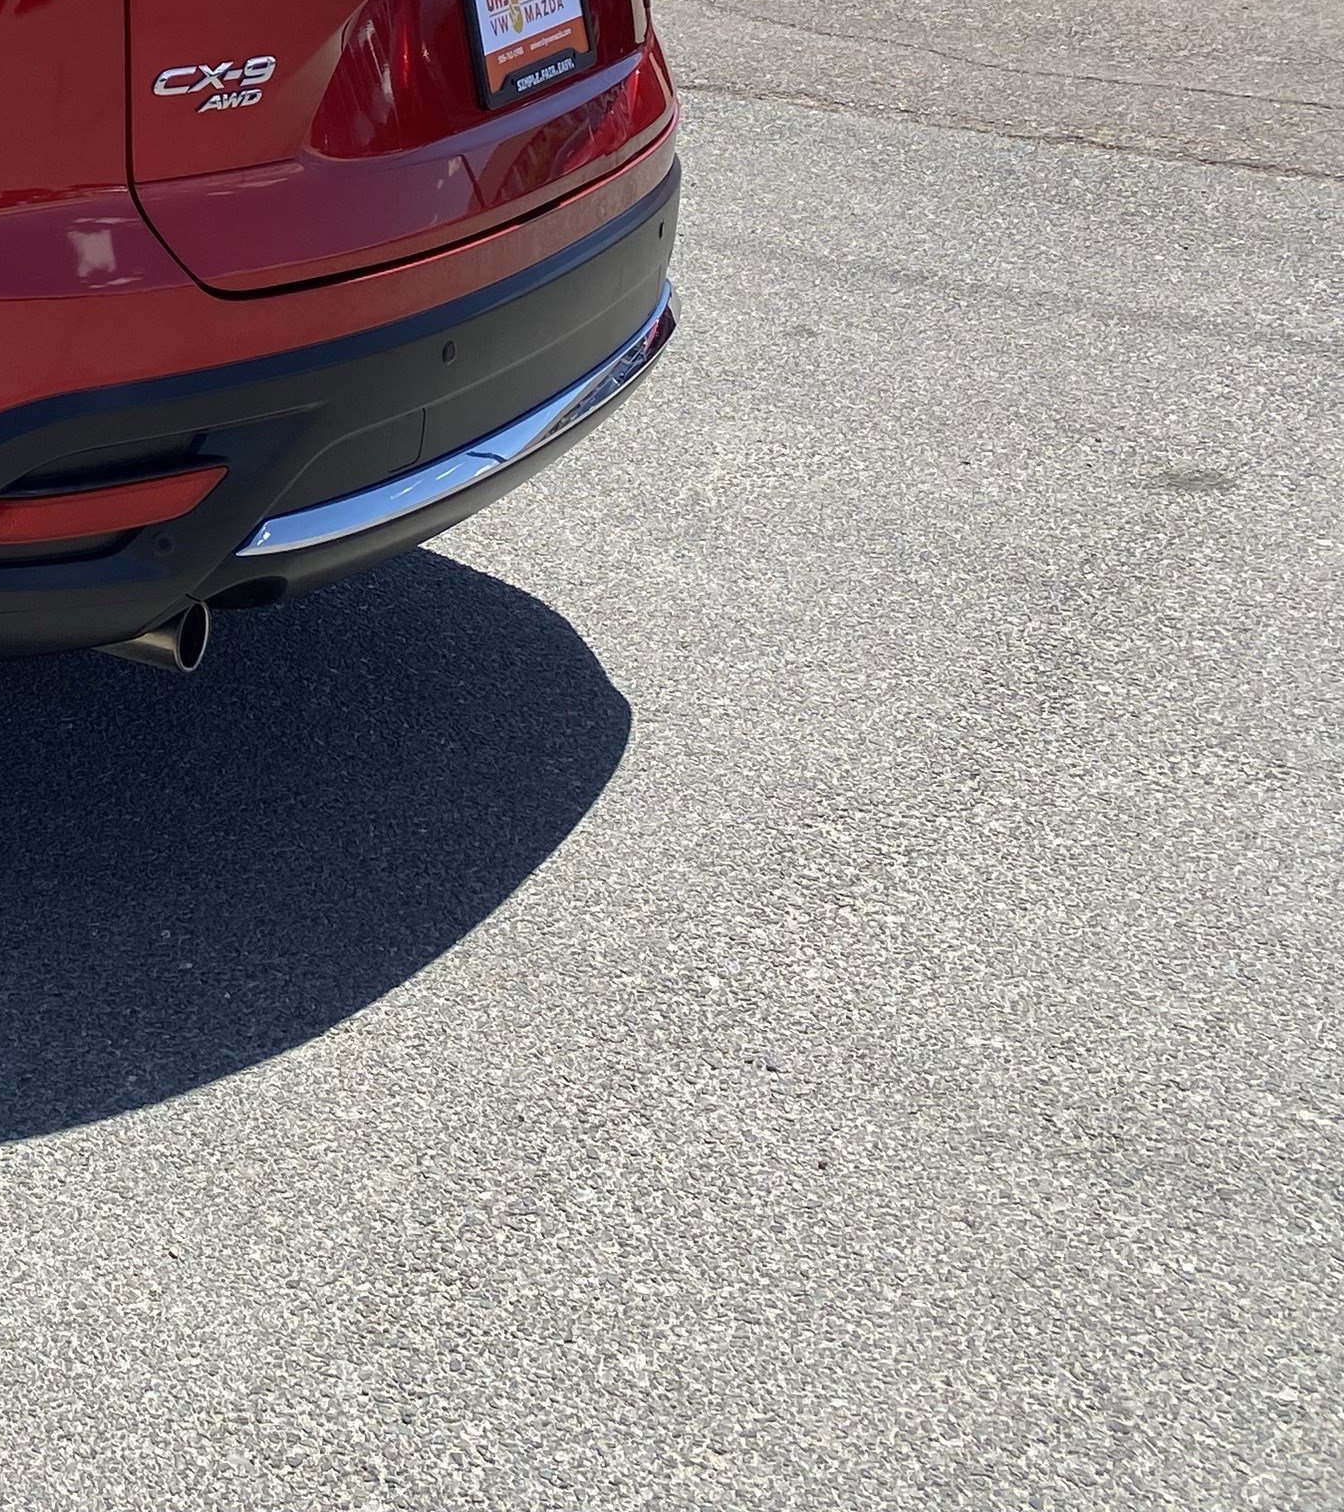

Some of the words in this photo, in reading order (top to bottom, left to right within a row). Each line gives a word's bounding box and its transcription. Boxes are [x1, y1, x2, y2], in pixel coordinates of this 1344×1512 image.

[490, 17, 509, 36] VW
[153, 55, 276, 96] CX-9
[197, 89, 262, 113] AWD
